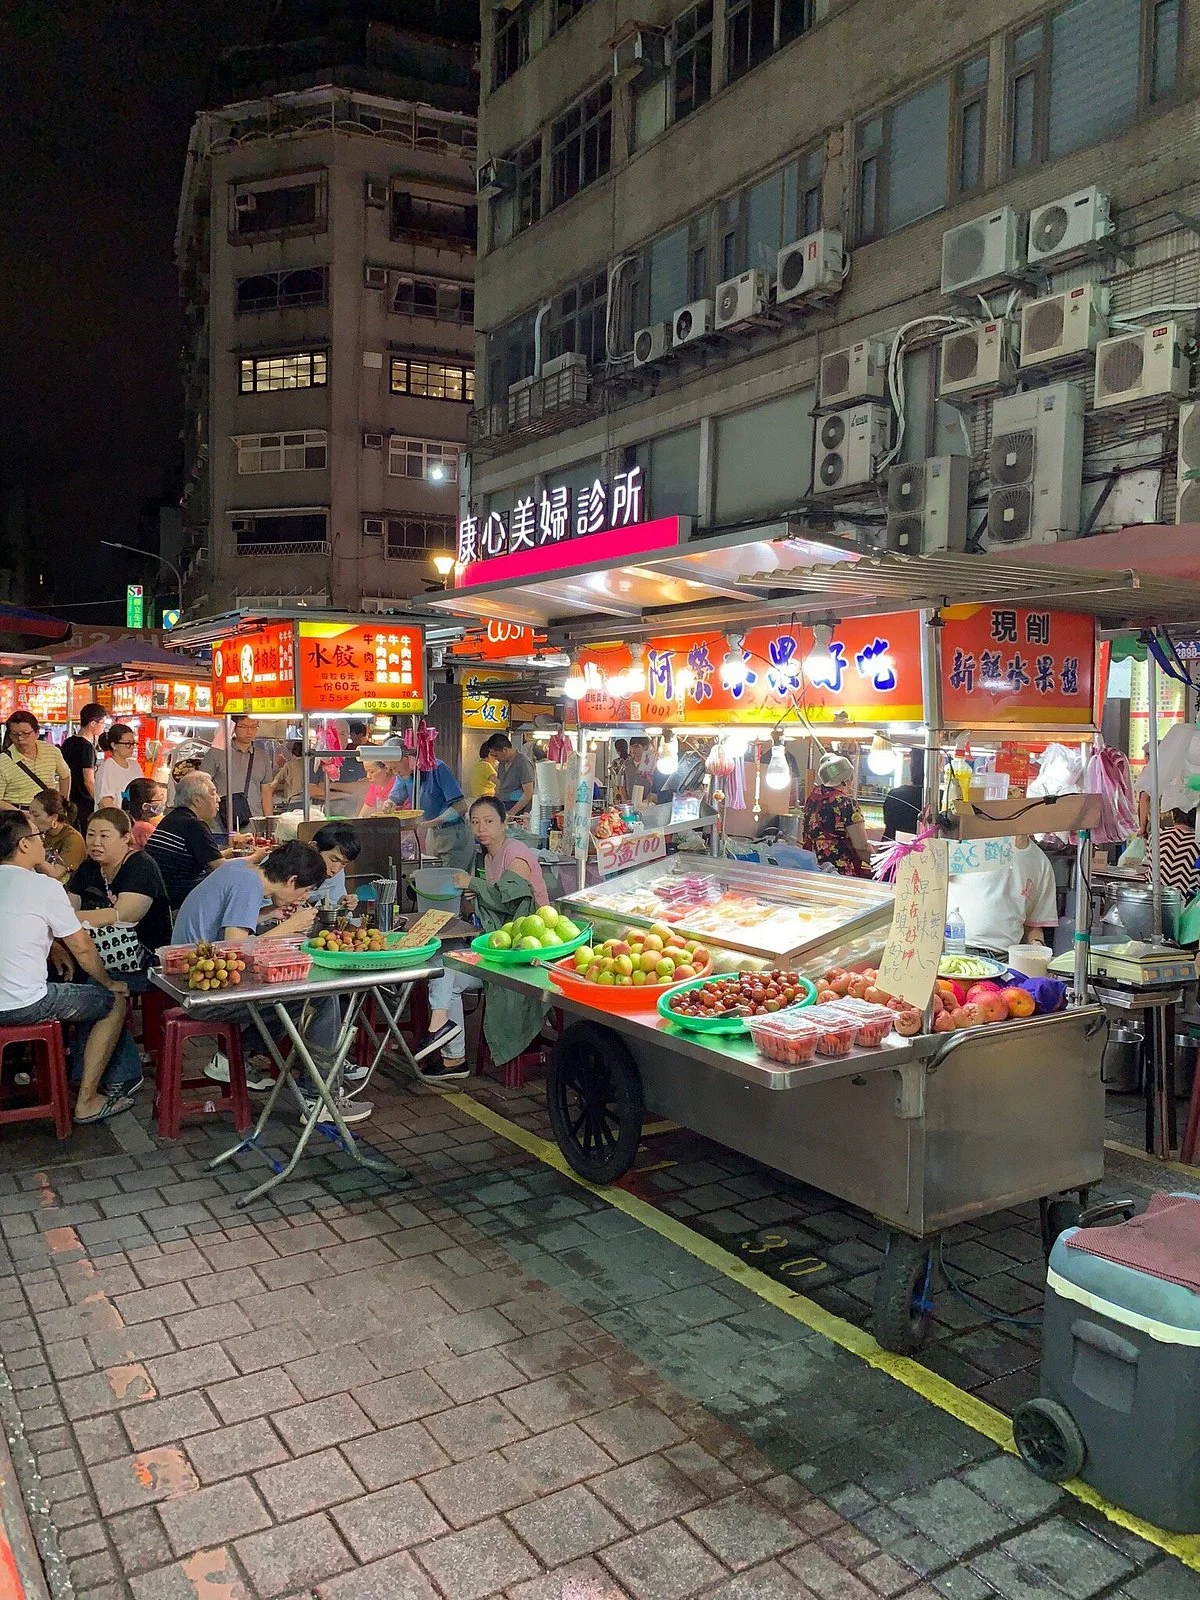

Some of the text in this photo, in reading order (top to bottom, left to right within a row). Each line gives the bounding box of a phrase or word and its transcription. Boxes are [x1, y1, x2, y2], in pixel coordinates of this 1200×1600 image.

[458, 466, 642, 562] 康心美婦診所
[990, 609, 1050, 644] 現削
[307, 642, 359, 669] 水餃
[313, 681, 360, 691] 一份60元
[411, 690, 418, 698] 大
